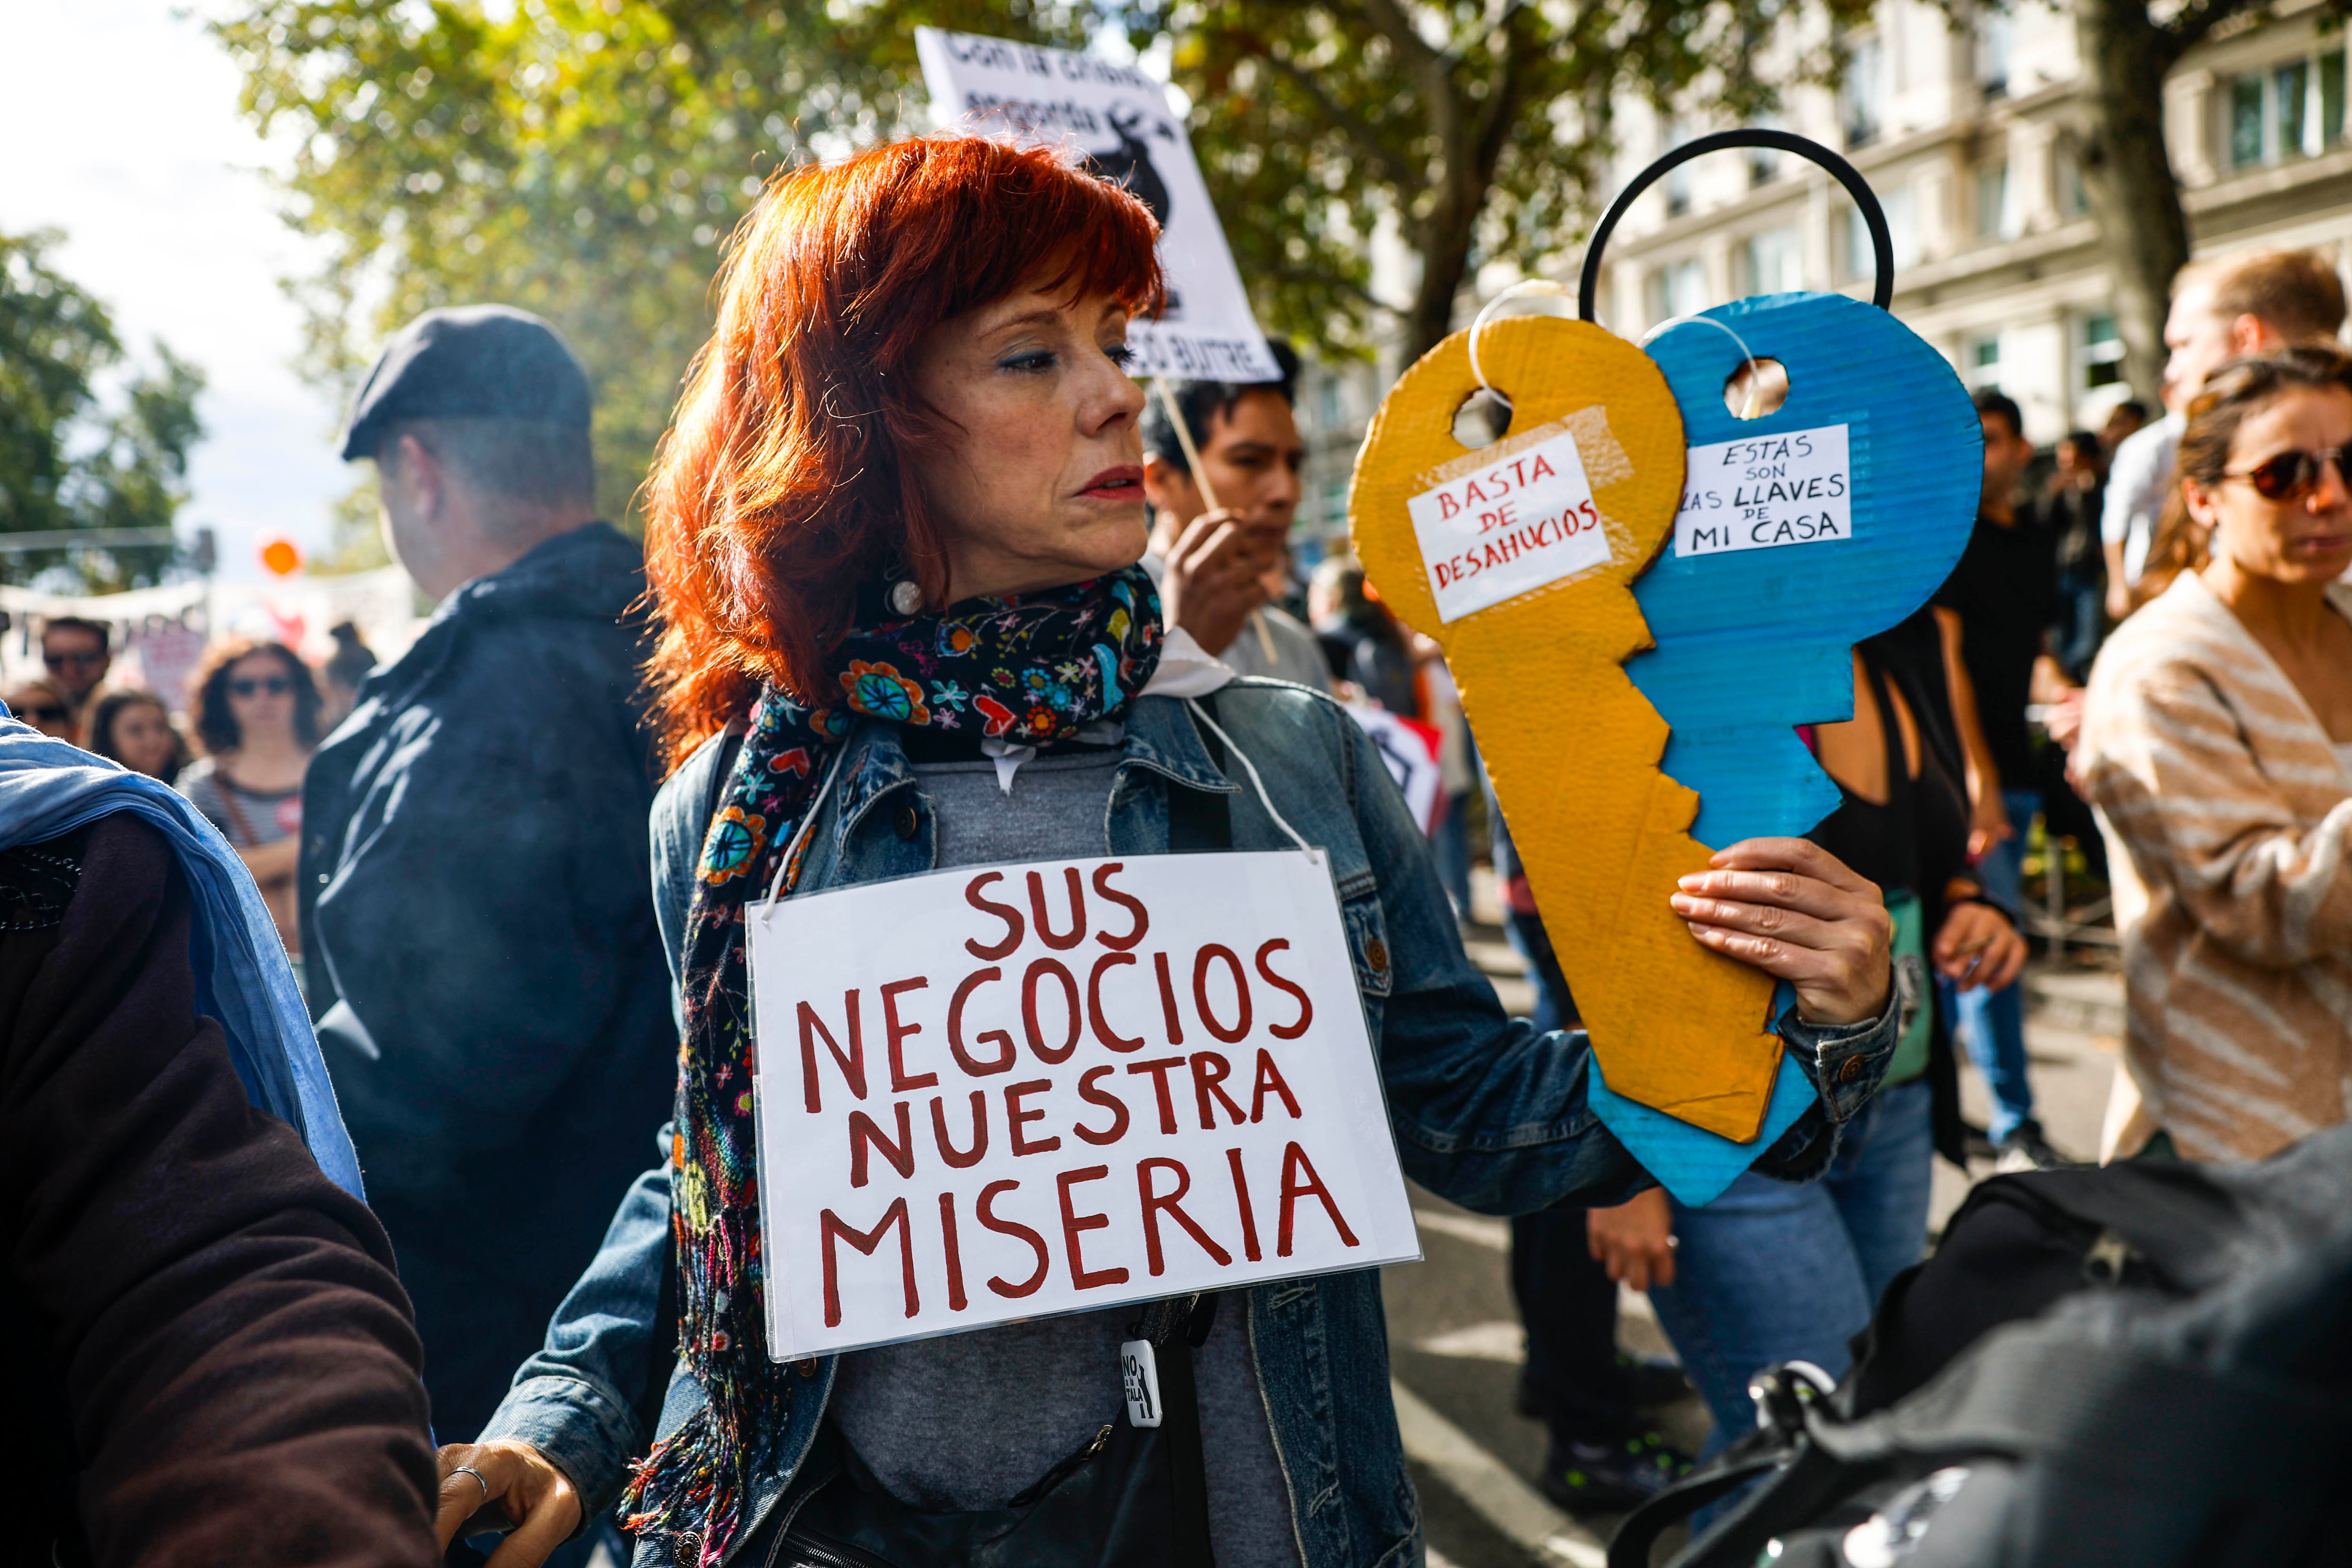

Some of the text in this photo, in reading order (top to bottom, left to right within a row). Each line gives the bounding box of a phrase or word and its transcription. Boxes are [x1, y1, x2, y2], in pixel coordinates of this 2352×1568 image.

[1722, 435, 1812, 466] ESTAS
[1436, 454, 1556, 522] BASTA
[1745, 462, 1786, 481] SON
[1679, 474, 1844, 512] LAS LLAVES
[1478, 501, 1518, 535] DE
[1692, 511, 1838, 550] MI CASA
[1742, 507, 1769, 521] DE
[1434, 499, 1598, 590] DESAHUCIOS
[966, 863, 1149, 961] SUS
[797, 939, 1313, 1113] NEGOCIOS
[850, 1049, 1302, 1188] NUESTRA
[821, 1142, 1359, 1327] MISERIA
[1122, 1355, 1137, 1377] NO
[1129, 1377, 1135, 1386] la
[1126, 1387, 1143, 1402] TALA
